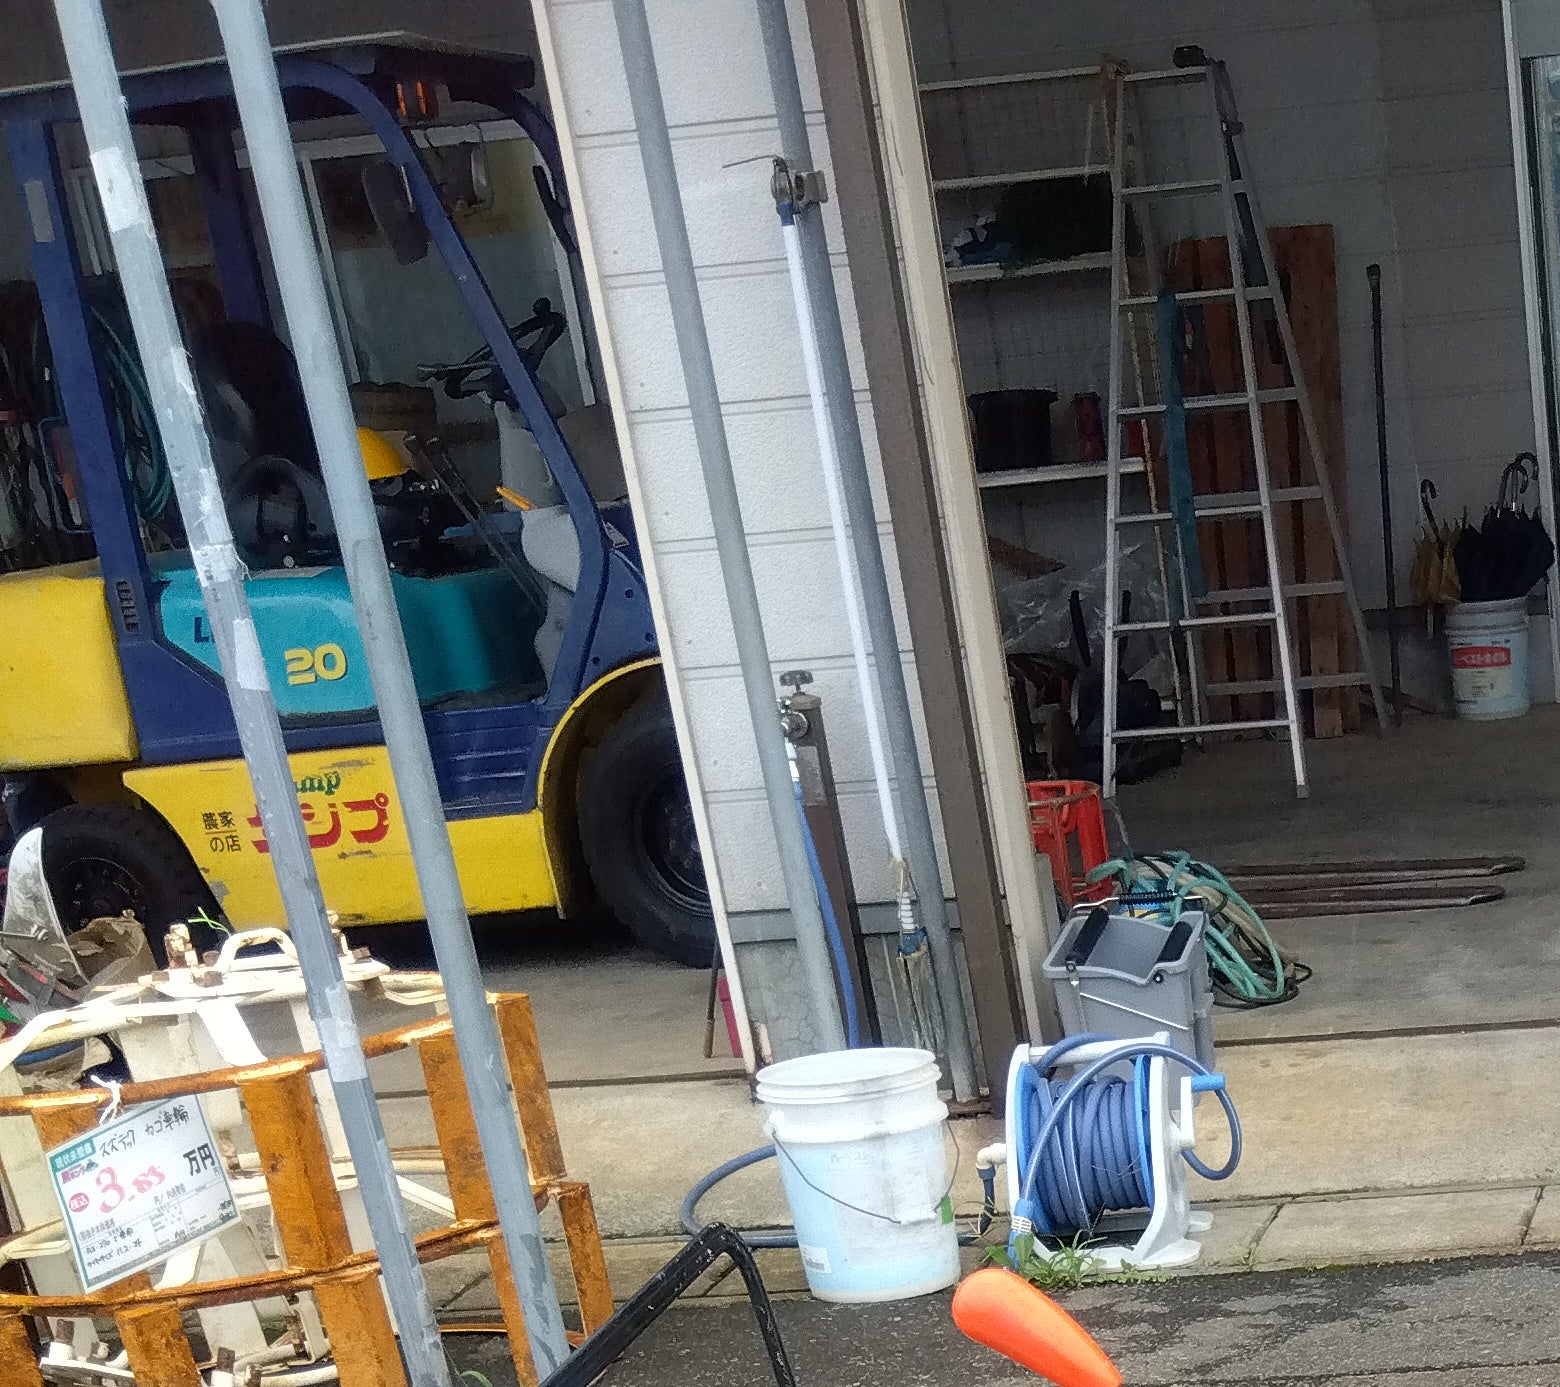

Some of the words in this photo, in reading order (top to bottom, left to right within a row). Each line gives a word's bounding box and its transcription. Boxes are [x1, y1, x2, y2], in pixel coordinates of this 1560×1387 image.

[284, 642, 348, 685] 20
[202, 810, 236, 831] 農家
[209, 834, 242, 853] の店
[183, 1143, 216, 1177] 万円
